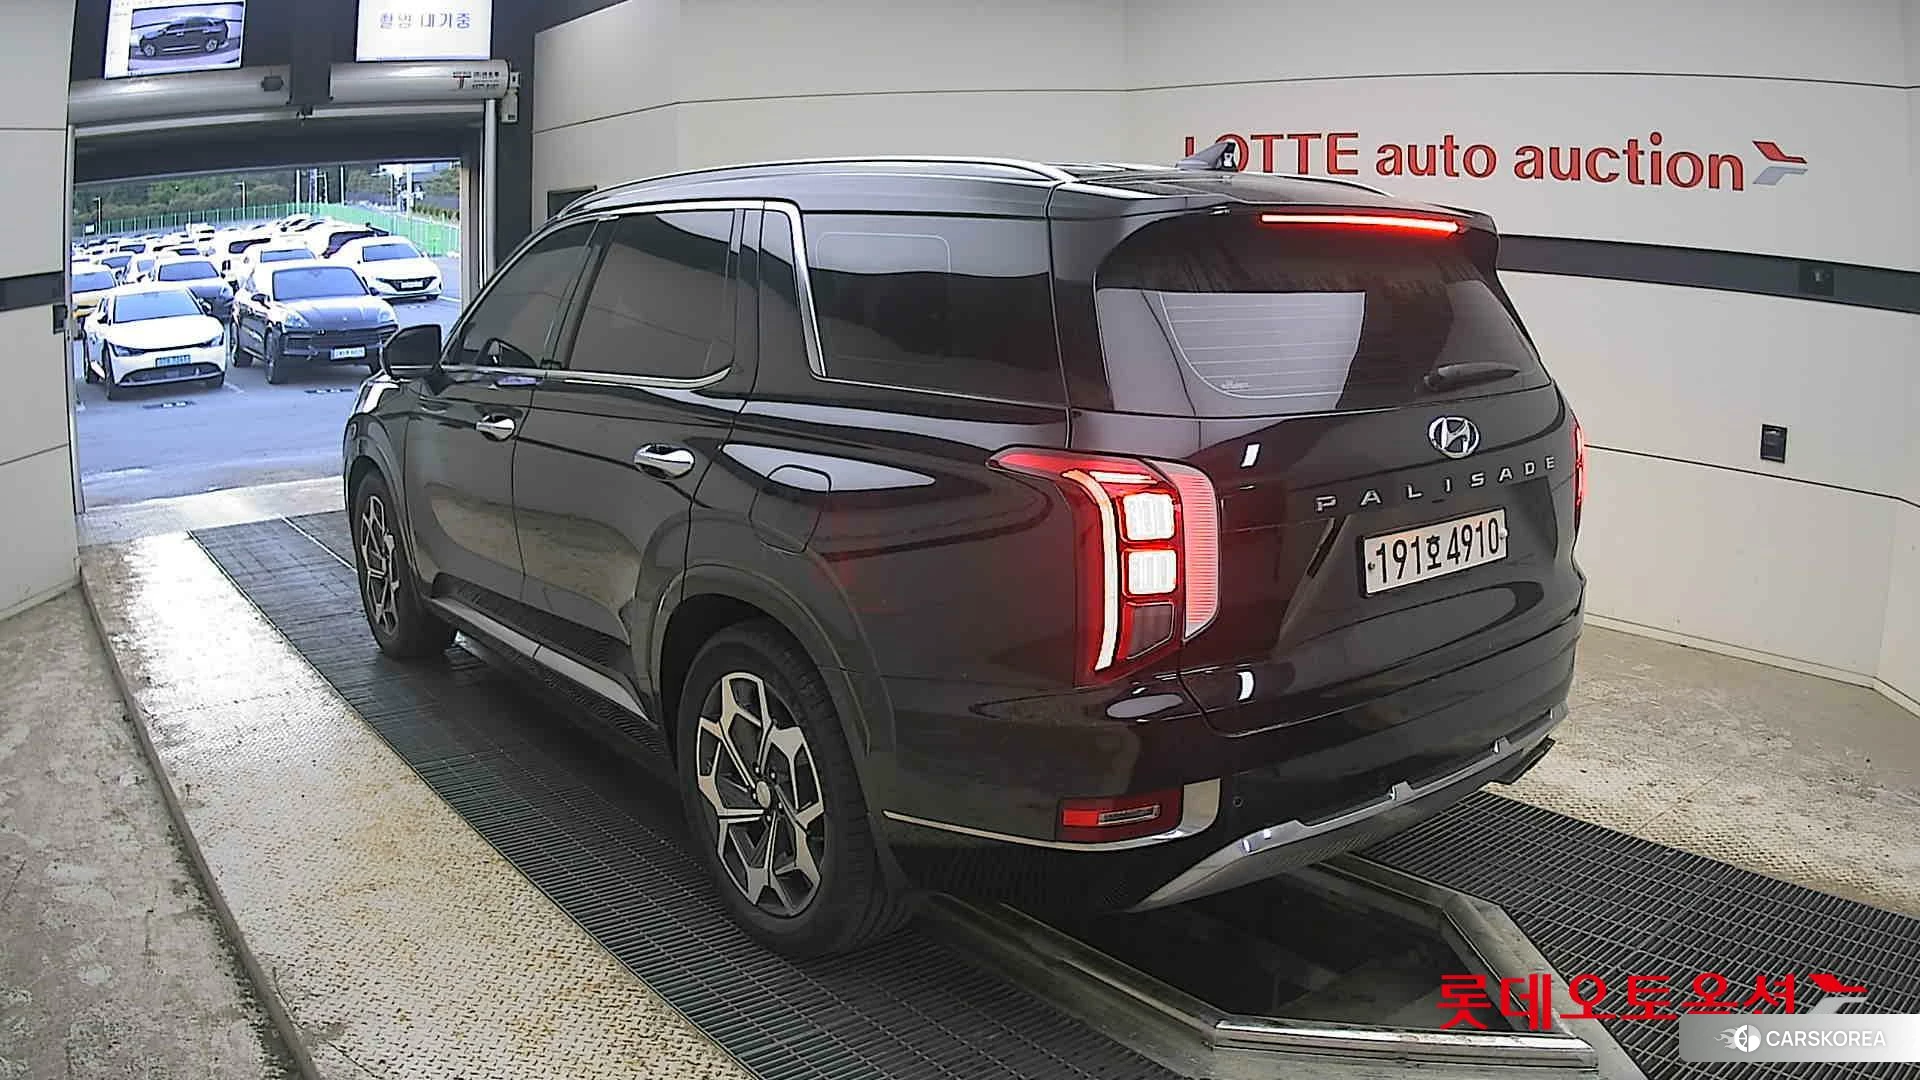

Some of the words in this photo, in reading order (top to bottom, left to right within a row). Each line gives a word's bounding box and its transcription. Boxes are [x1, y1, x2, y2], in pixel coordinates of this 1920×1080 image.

[420, 12, 470, 29] 대기중
[1376, 134, 1497, 179] auto
[1514, 131, 1744, 191] auction
[1314, 456, 1556, 512] PALISADE
[1375, 517, 1499, 583] 191호4910
